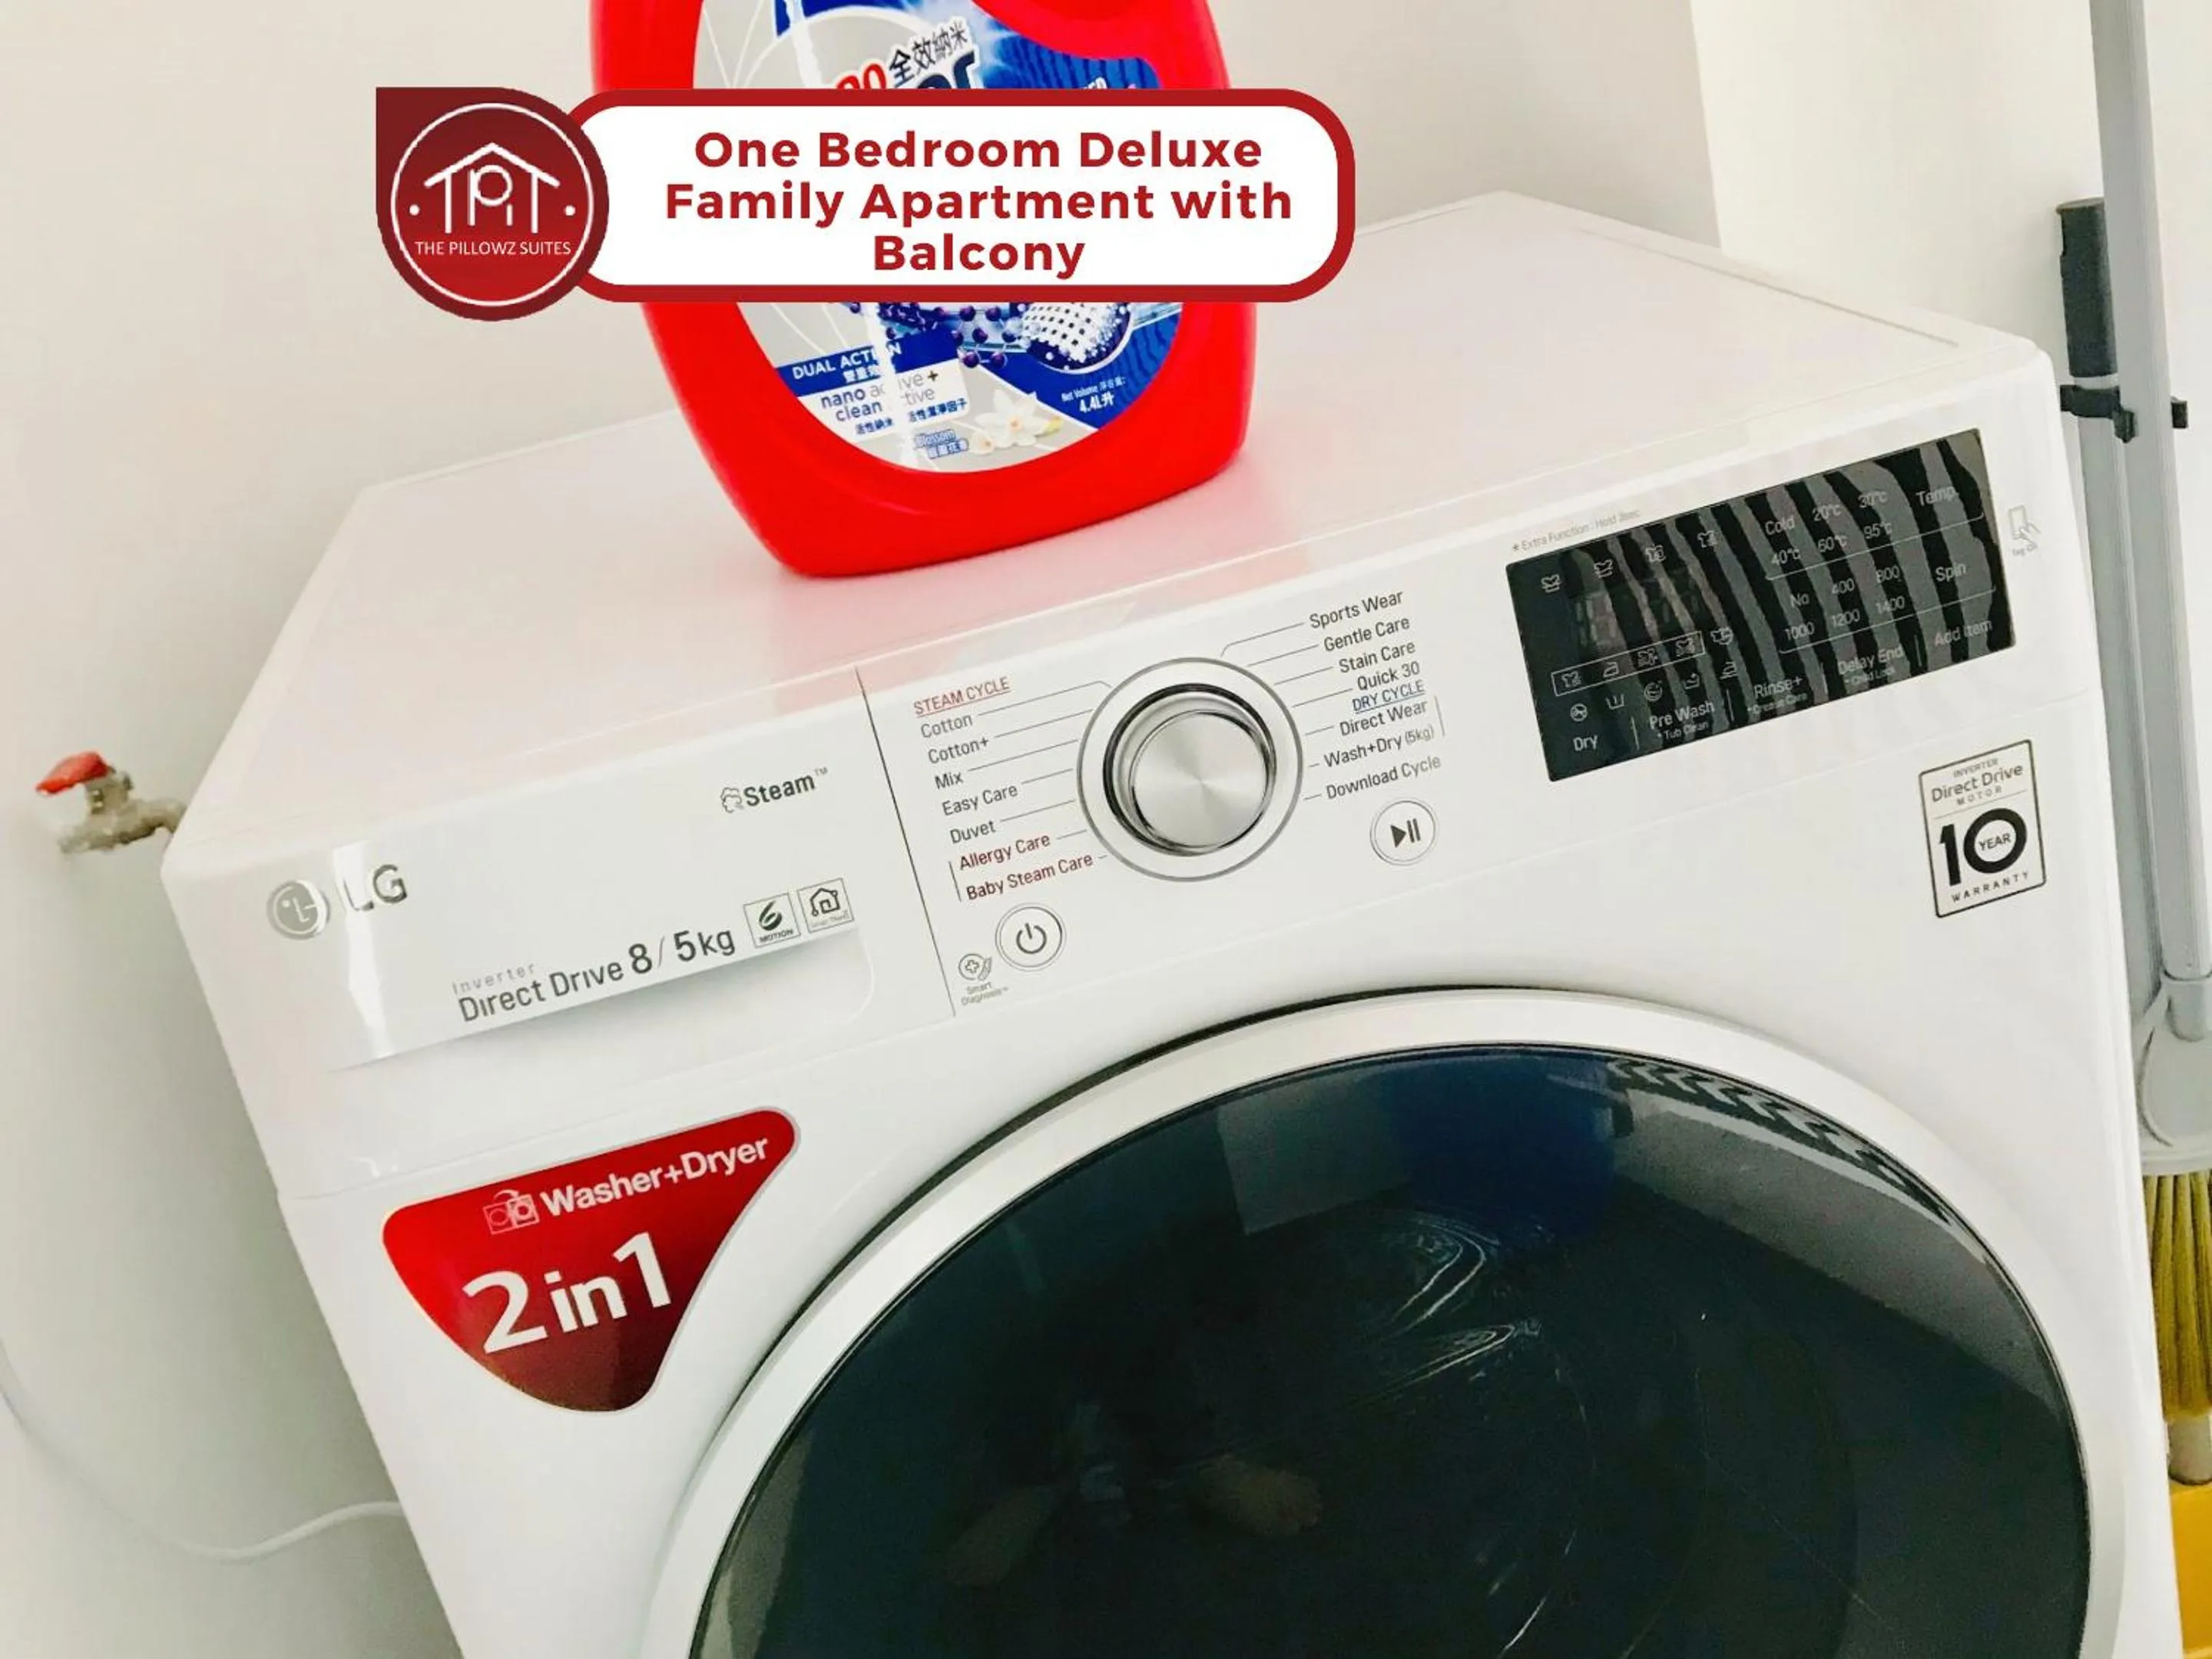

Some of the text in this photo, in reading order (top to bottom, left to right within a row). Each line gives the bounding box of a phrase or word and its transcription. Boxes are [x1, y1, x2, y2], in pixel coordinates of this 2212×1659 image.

[792, 360, 836, 379] DUAL
[821, 388, 865, 409] nano
[836, 401, 882, 422] clean
[1765, 516, 1796, 535] Cold
[1791, 561, 1967, 608] No 400 800 Spin
[1310, 590, 1403, 630] Sports Wear
[1785, 595, 1904, 641] 1000 1200 1400
[1323, 617, 1410, 651] Gentle Care
[1339, 641, 1416, 674] Stain Care
[1357, 661, 1420, 691] Quick 30
[1574, 735, 1598, 751] Dry
[1650, 714, 1673, 729] Pre
[1675, 700, 1715, 721] Wash
[1753, 676, 1803, 699] Rinse+
[1838, 655, 1875, 674] Delay
[1878, 644, 1903, 662] End
[1934, 630, 1962, 647] Add
[914, 676, 1010, 716] STEAM CYCLE
[1352, 680, 1425, 713] DRY CYCLE
[920, 715, 973, 739] Cotton
[1340, 700, 1429, 737] Direct Wear
[928, 737, 990, 764] Cotton+
[1323, 724, 1435, 768] Wash+Dry (5kg)
[935, 771, 964, 790] Mix
[1326, 756, 1442, 799] Download Cycle
[1932, 765, 2023, 802] Direct Drive
[942, 784, 1018, 817] Easy Care
[1956, 786, 2002, 805] MOTOR
[950, 820, 996, 844] Duvet
[1939, 808, 2028, 886] 10
[1978, 832, 2011, 851] YEAR
[959, 833, 1051, 871] Allergy Care
[966, 854, 1093, 901] Baby Steam Care
[1951, 872, 2029, 902] WARRANTY
[759, 929, 794, 943] MOTION
[452, 963, 536, 994] Inverter
[459, 980, 547, 1022] Direct
[549, 961, 624, 997] Drive
[540, 1137, 768, 1217] Washer+Dryer
